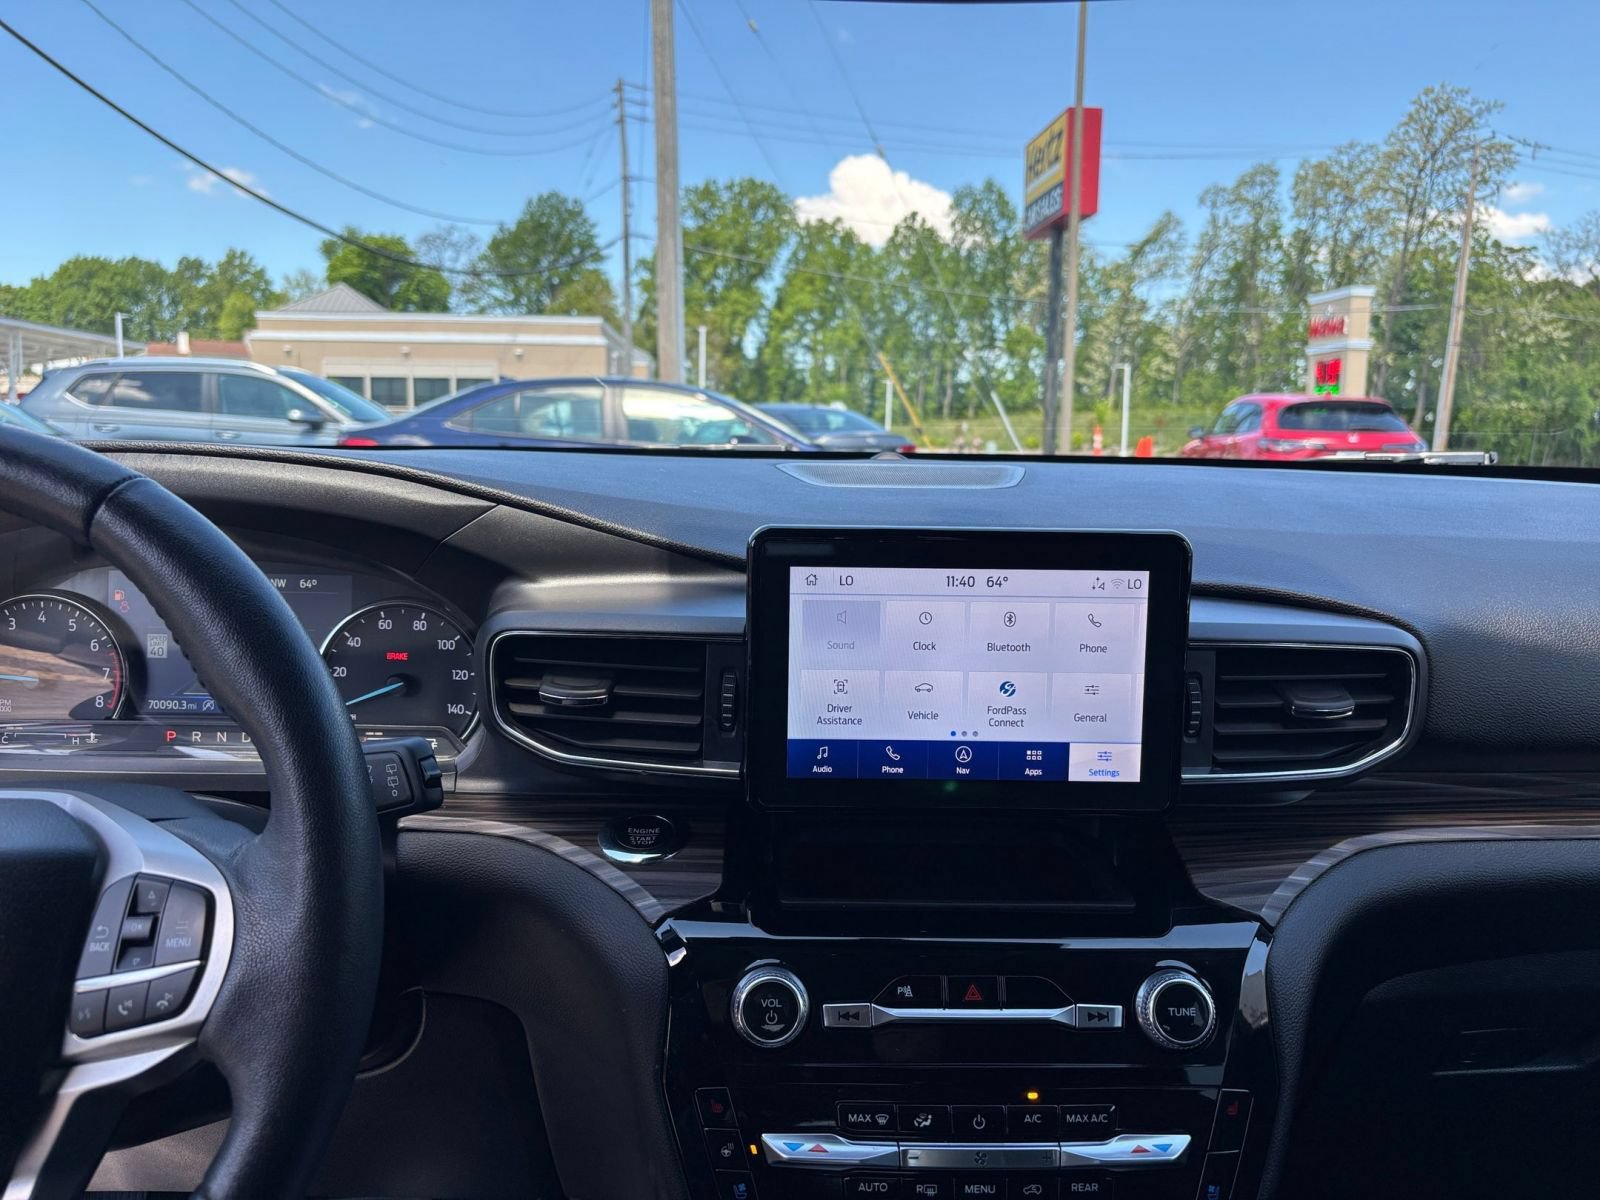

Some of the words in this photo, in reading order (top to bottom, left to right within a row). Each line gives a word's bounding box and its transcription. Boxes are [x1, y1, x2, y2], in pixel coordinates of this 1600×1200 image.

[839, 575, 854, 586] LO
[946, 575, 976, 588] 11:40
[1127, 579, 1142, 590] LO
[37, 611, 47, 624] 4
[8, 618, 17, 631] 3
[67, 619, 78, 632] 5
[378, 619, 393, 631] 60
[412, 620, 428, 632] 80
[90, 638, 99, 652] 6
[347, 636, 362, 648] 40
[437, 639, 456, 651] 100
[827, 640, 855, 650] Sound
[912, 641, 937, 651] Clock
[986, 642, 1031, 652] Bluetooth
[150, 646, 164, 657] 40
[1079, 643, 1108, 654] Phone
[386, 652, 408, 661] BRAKE
[102, 667, 111, 680] 7
[333, 667, 347, 678] 20
[452, 670, 469, 681] 120
[95, 695, 104, 708] 8
[148, 699, 187, 710] 70090.3
[447, 703, 465, 715] 140
[827, 703, 853, 713] Driver
[987, 705, 1027, 716] FordPass
[816, 715, 863, 726] Assistance
[907, 710, 939, 721] Vehicle
[1073, 712, 1107, 723] General
[988, 717, 1025, 728] Connect
[72, 737, 80, 745] H
[166, 731, 177, 742] P
[192, 731, 202, 742] R
[217, 731, 227, 742] N
[812, 765, 833, 773] Audio
[881, 765, 904, 775] Phone
[956, 766, 970, 775] Nav
[1024, 767, 1043, 777] Apps
[1088, 768, 1120, 779] Settings
[89, 941, 110, 951] BACK
[165, 937, 192, 948] MENU
[761, 998, 782, 1009] VOL
[1168, 1007, 1197, 1016] TUNE
[848, 1113, 872, 1123] MAX
[1024, 1114, 1042, 1123] A/C
[1066, 1114, 1089, 1123] MAX
[1091, 1114, 1109, 1123] A/C
[858, 1182, 888, 1192] AUTO
[964, 1184, 996, 1194] MENU
[1071, 1182, 1099, 1192] REAR
